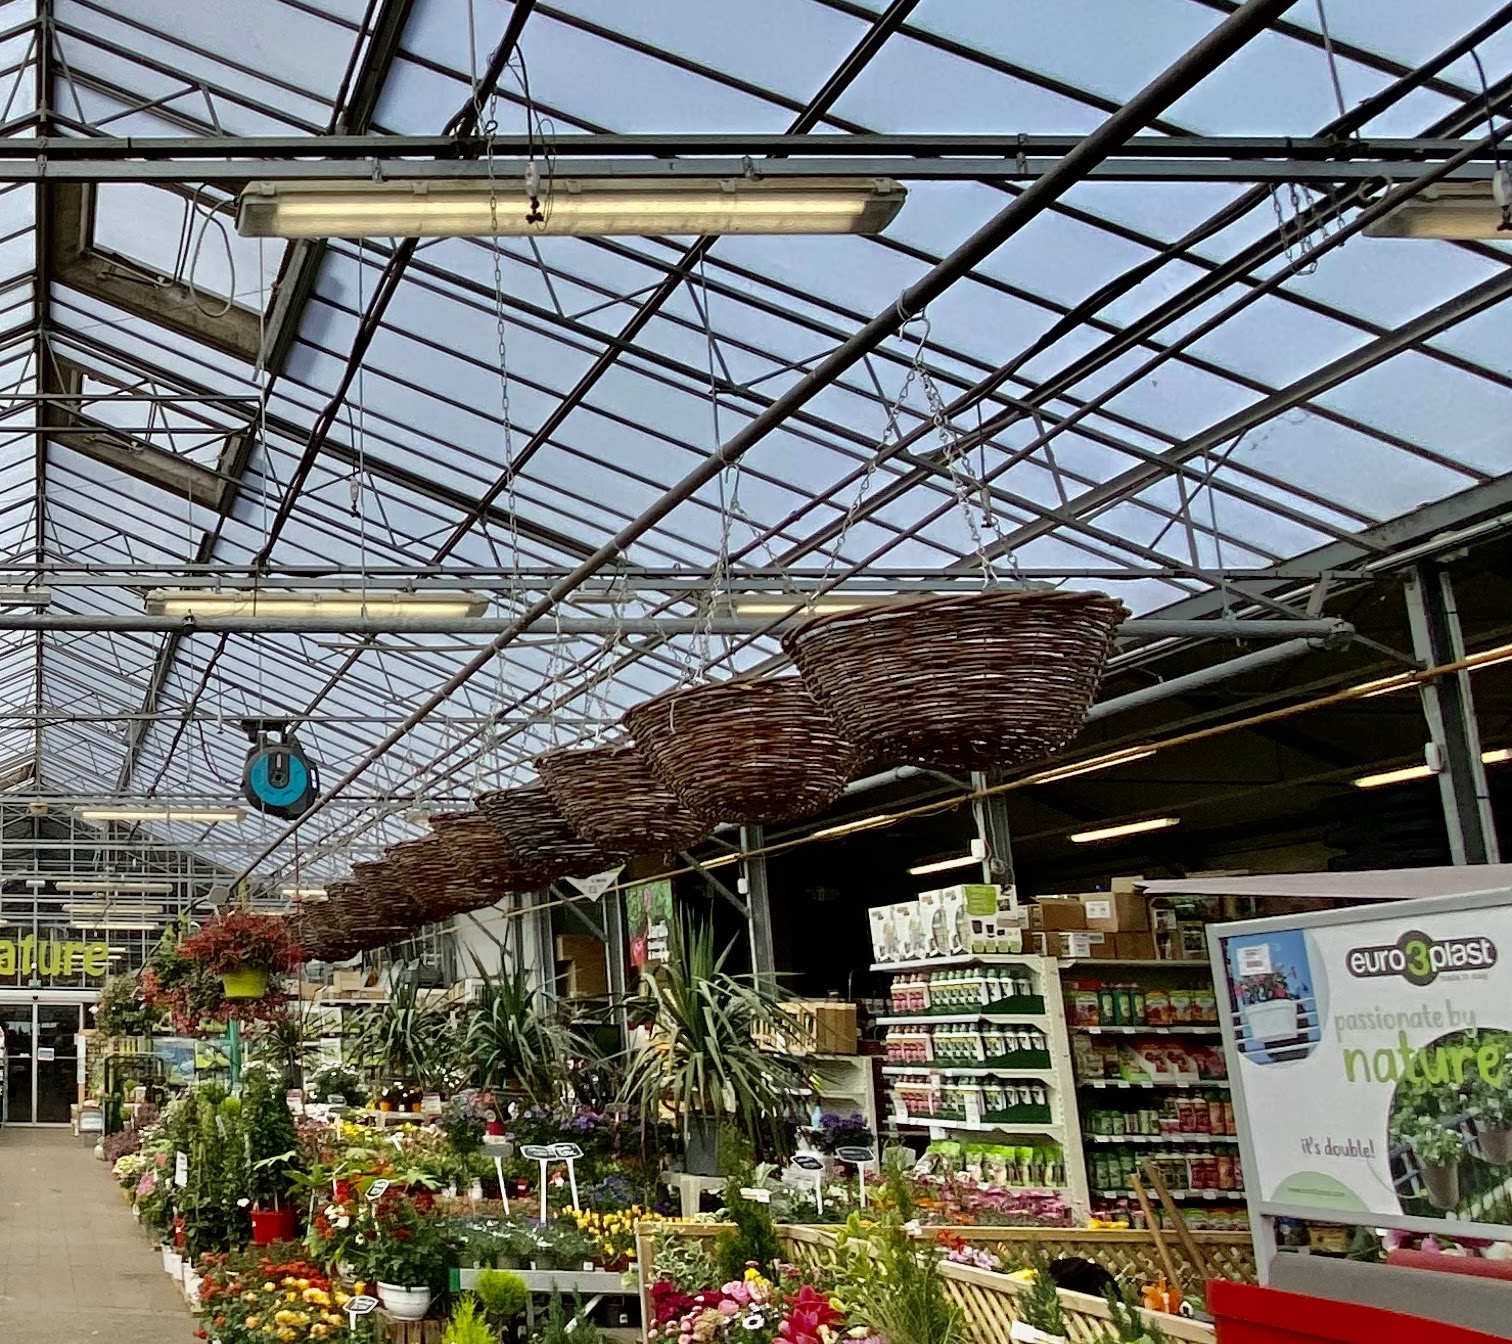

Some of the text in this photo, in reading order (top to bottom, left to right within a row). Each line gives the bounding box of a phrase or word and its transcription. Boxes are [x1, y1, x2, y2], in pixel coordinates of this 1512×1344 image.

[1350, 938, 1495, 976] euro3plast
[1334, 999, 1479, 1043] passionate by
[1343, 1030, 1504, 1087] nature
[1300, 1136, 1376, 1159] it's double!
